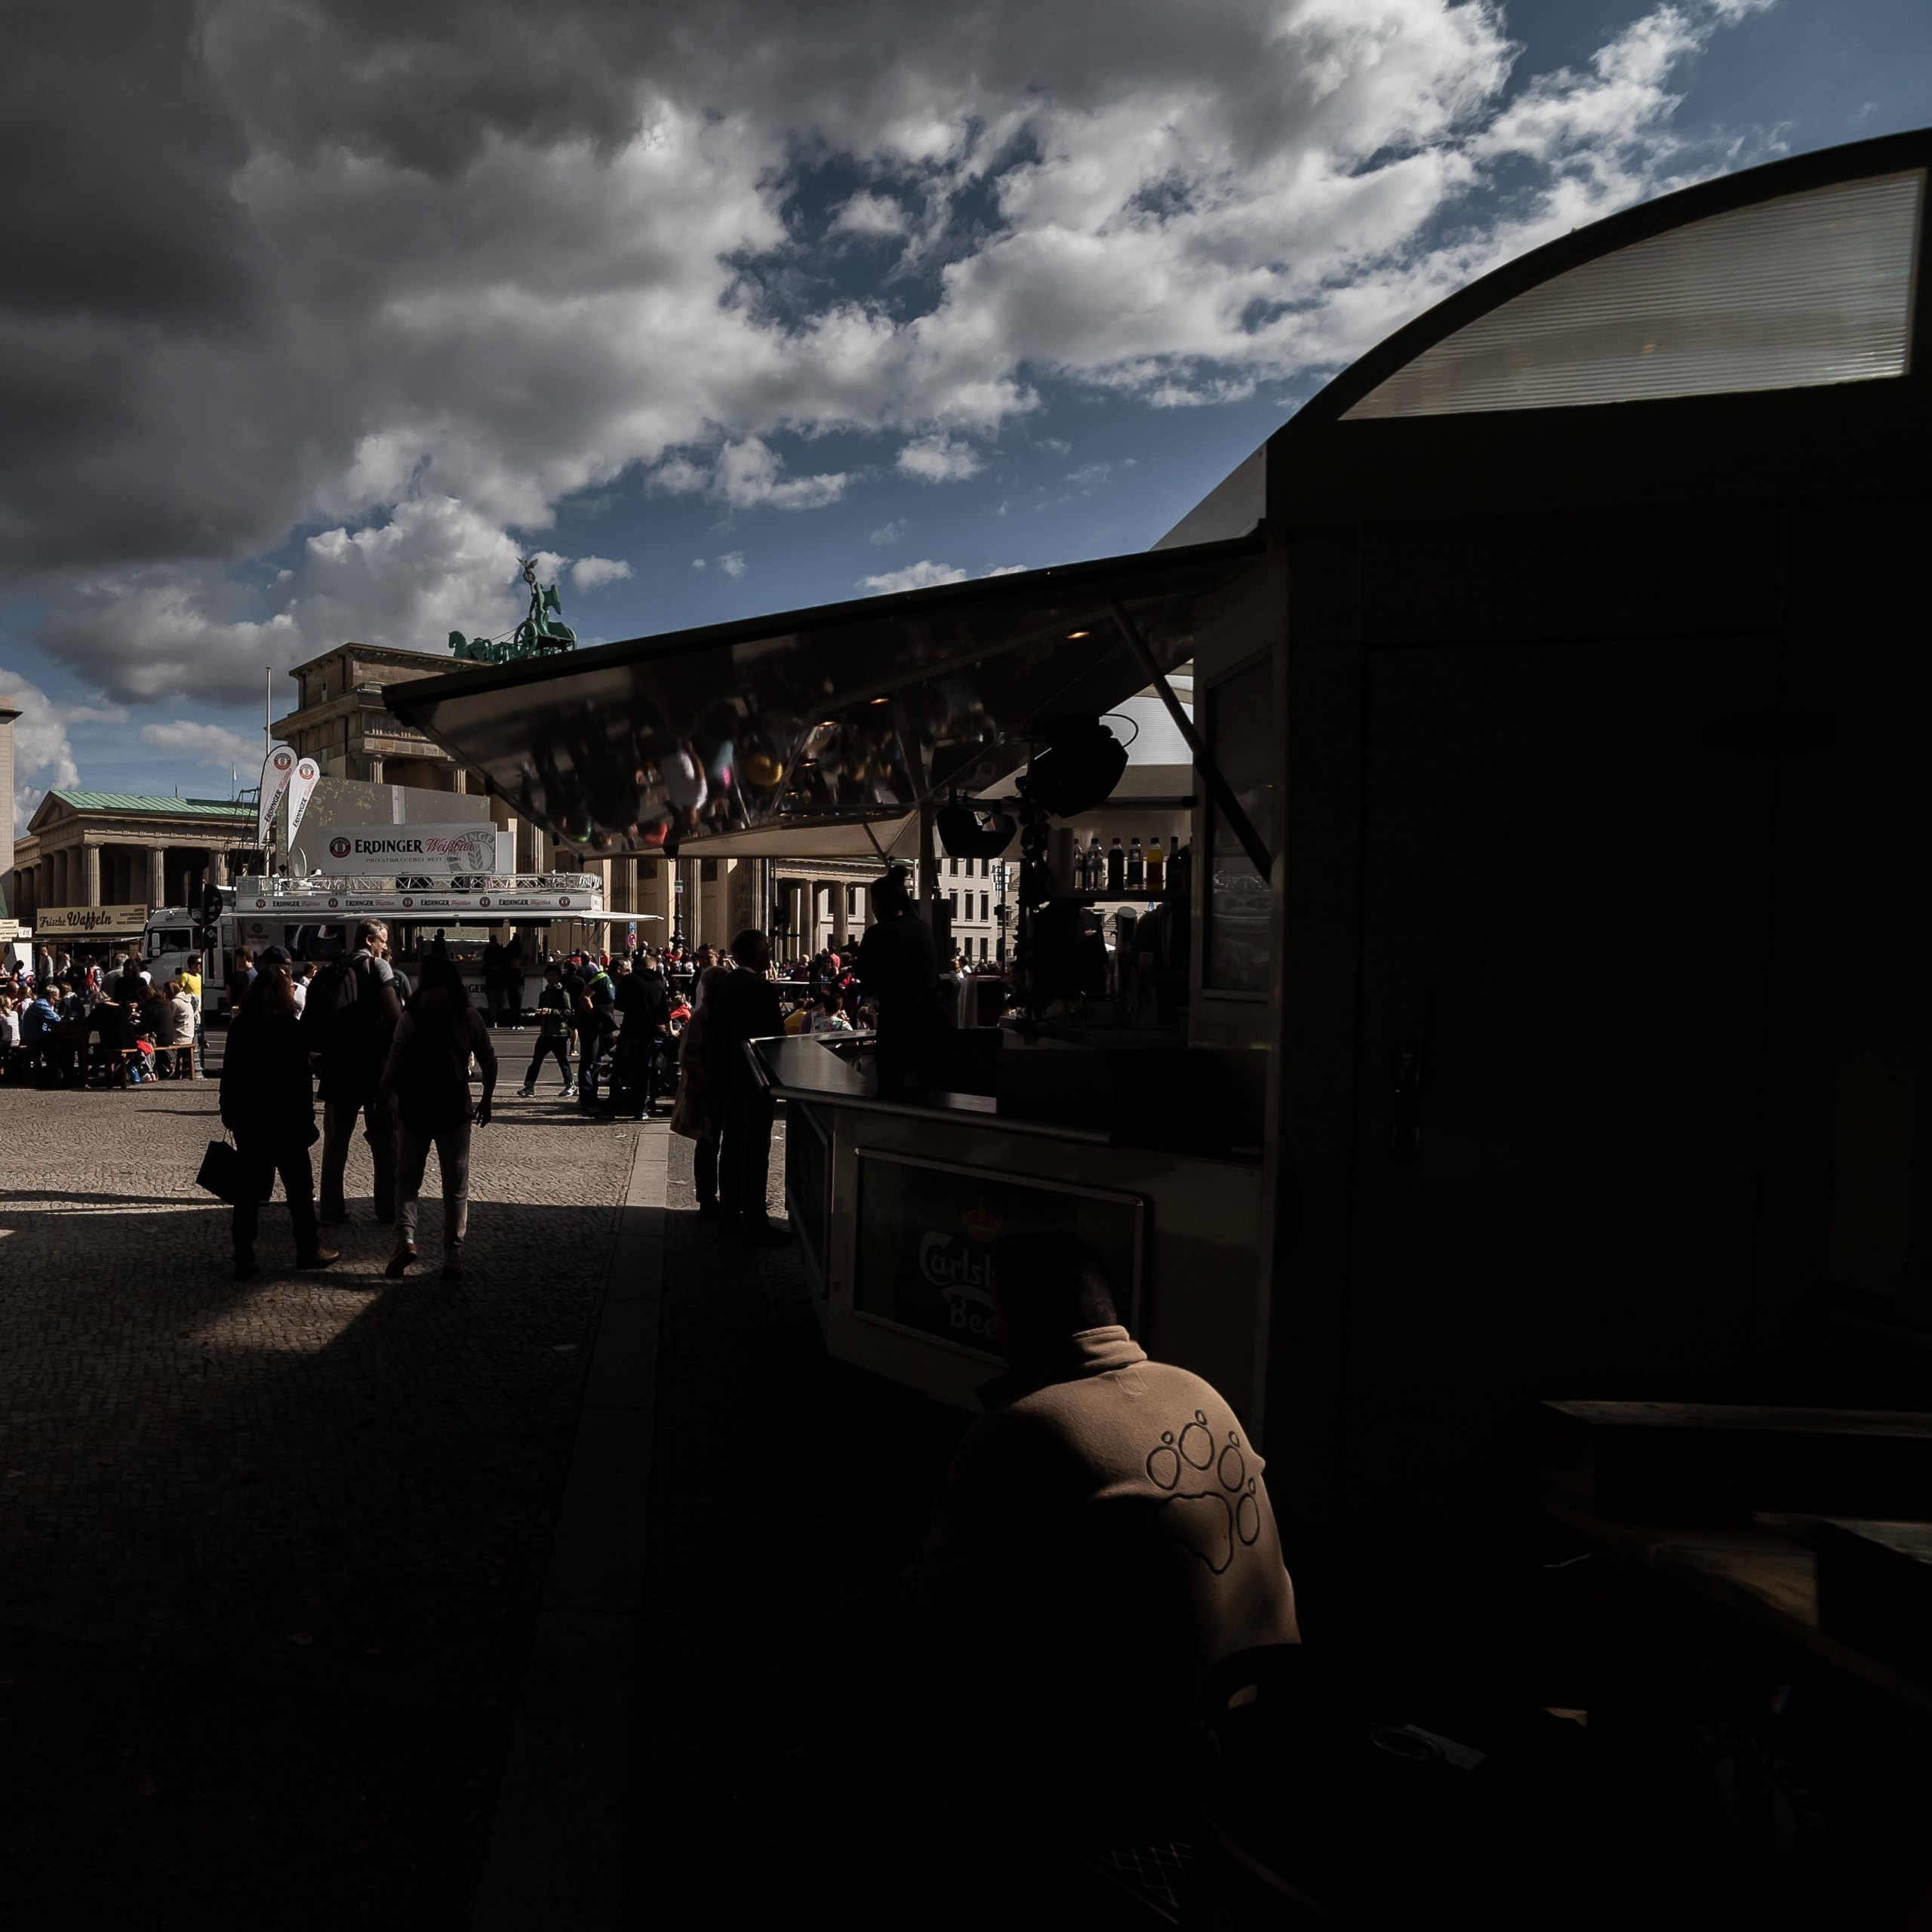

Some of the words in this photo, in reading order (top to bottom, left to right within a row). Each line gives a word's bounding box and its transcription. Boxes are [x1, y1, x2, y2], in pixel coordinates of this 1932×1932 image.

[264, 789, 283, 823] ERDINGER
[292, 797, 308, 828] ERDINGER
[355, 838, 423, 854] ERDINGER
[426, 838, 475, 855] Weißbier
[39, 916, 66, 928] Frische
[66, 910, 112, 931] Waffeln
[949, 1297, 998, 1340] Bee
